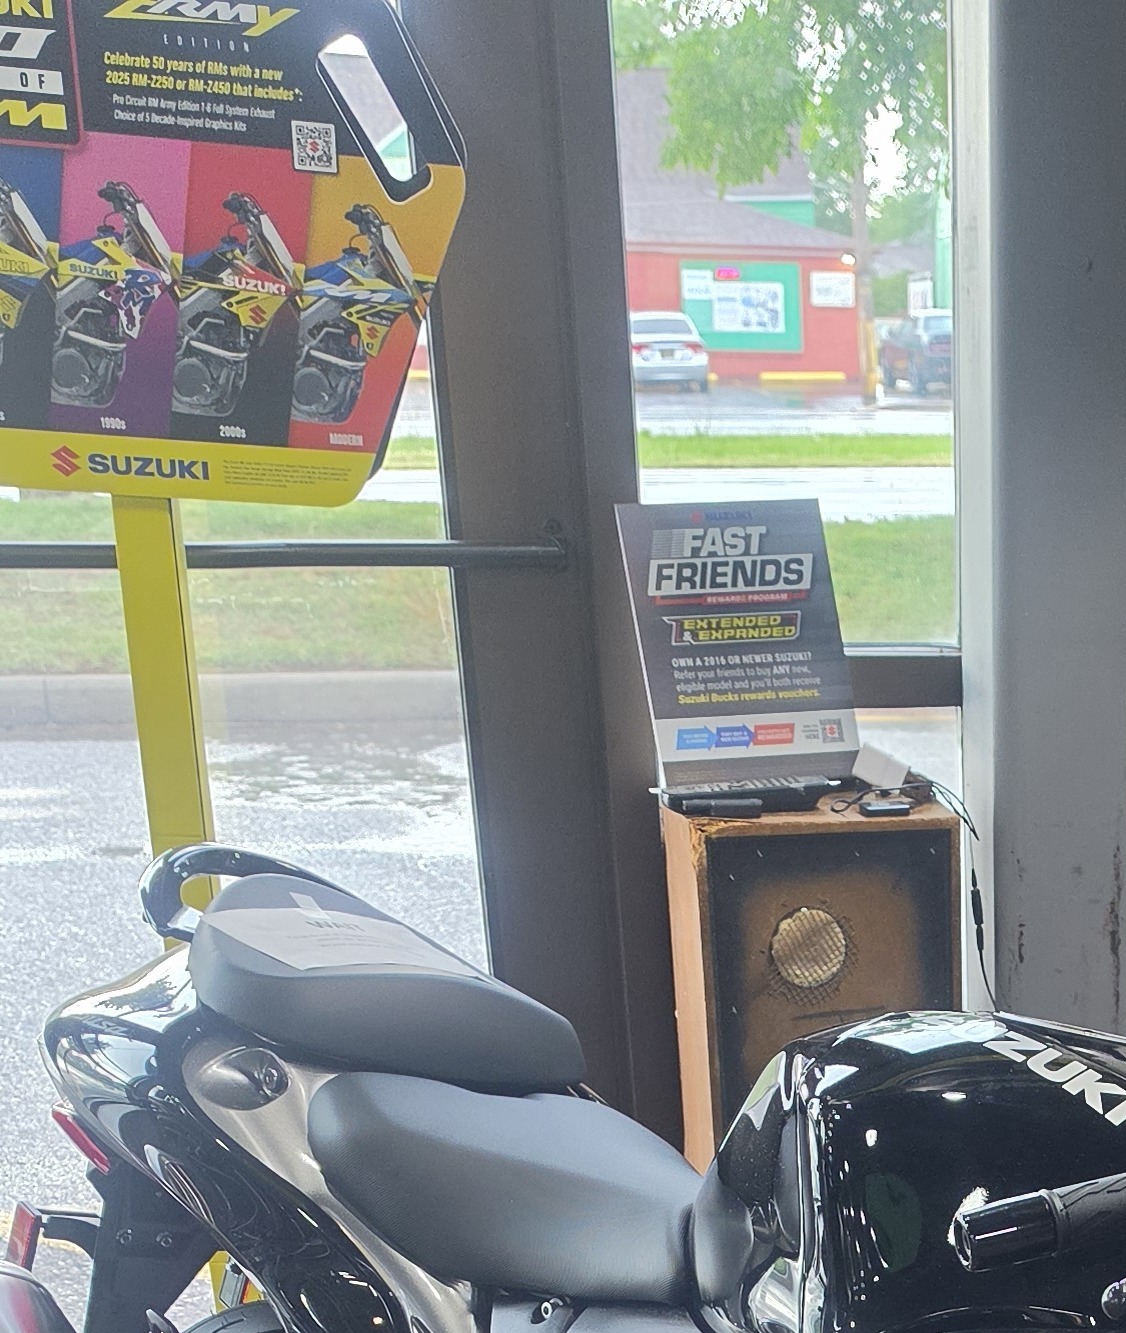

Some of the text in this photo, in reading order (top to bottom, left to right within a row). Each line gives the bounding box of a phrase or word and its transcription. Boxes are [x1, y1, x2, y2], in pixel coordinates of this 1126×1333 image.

[163, 33, 250, 53] EDITION
[104, 51, 283, 81] Celebrate 50 years of RMs with a new
[19, 72, 46, 90] OF
[106, 70, 130, 86] 2025
[131, 73, 175, 90] RM-Z250
[176, 79, 187, 91] or
[188, 79, 231, 95] RM-Z450
[232, 83, 253, 98] that
[112, 94, 125, 105] Pro
[177, 99, 199, 112] Edition
[114, 109, 136, 122] Choice
[137, 111, 144, 123] of
[204, 117, 233, 131] Graphics
[233, 120, 247, 132] Kits
[69, 263, 118, 279] SUZUKI
[100, 416, 127, 431] 1990s
[218, 424, 247, 439] 2000s
[88, 453, 210, 481] SUZUKI
[683, 526, 767, 557] FAST
[655, 557, 805, 592] FRIENDS
[683, 615, 782, 630] EXTENDED
[682, 626, 797, 642] & EXPANDED
[671, 656, 694, 668] OWN
[695, 656, 703, 667] A
[703, 655, 727, 667] 2016
[728, 655, 742, 665] OR
[742, 653, 773, 664] NEWER
[674, 669, 697, 680] Refer
[697, 668, 716, 680] your
[716, 667, 745, 679] friends
[746, 667, 756, 677] to
[756, 666, 771, 678] buy
[772, 664, 791, 675] ANY
[707, 679, 733, 691] model
[733, 678, 749, 689] and
[772, 676, 791, 688] both
[678, 693, 710, 705] Suzuki
[740, 690, 777, 702] rewards
